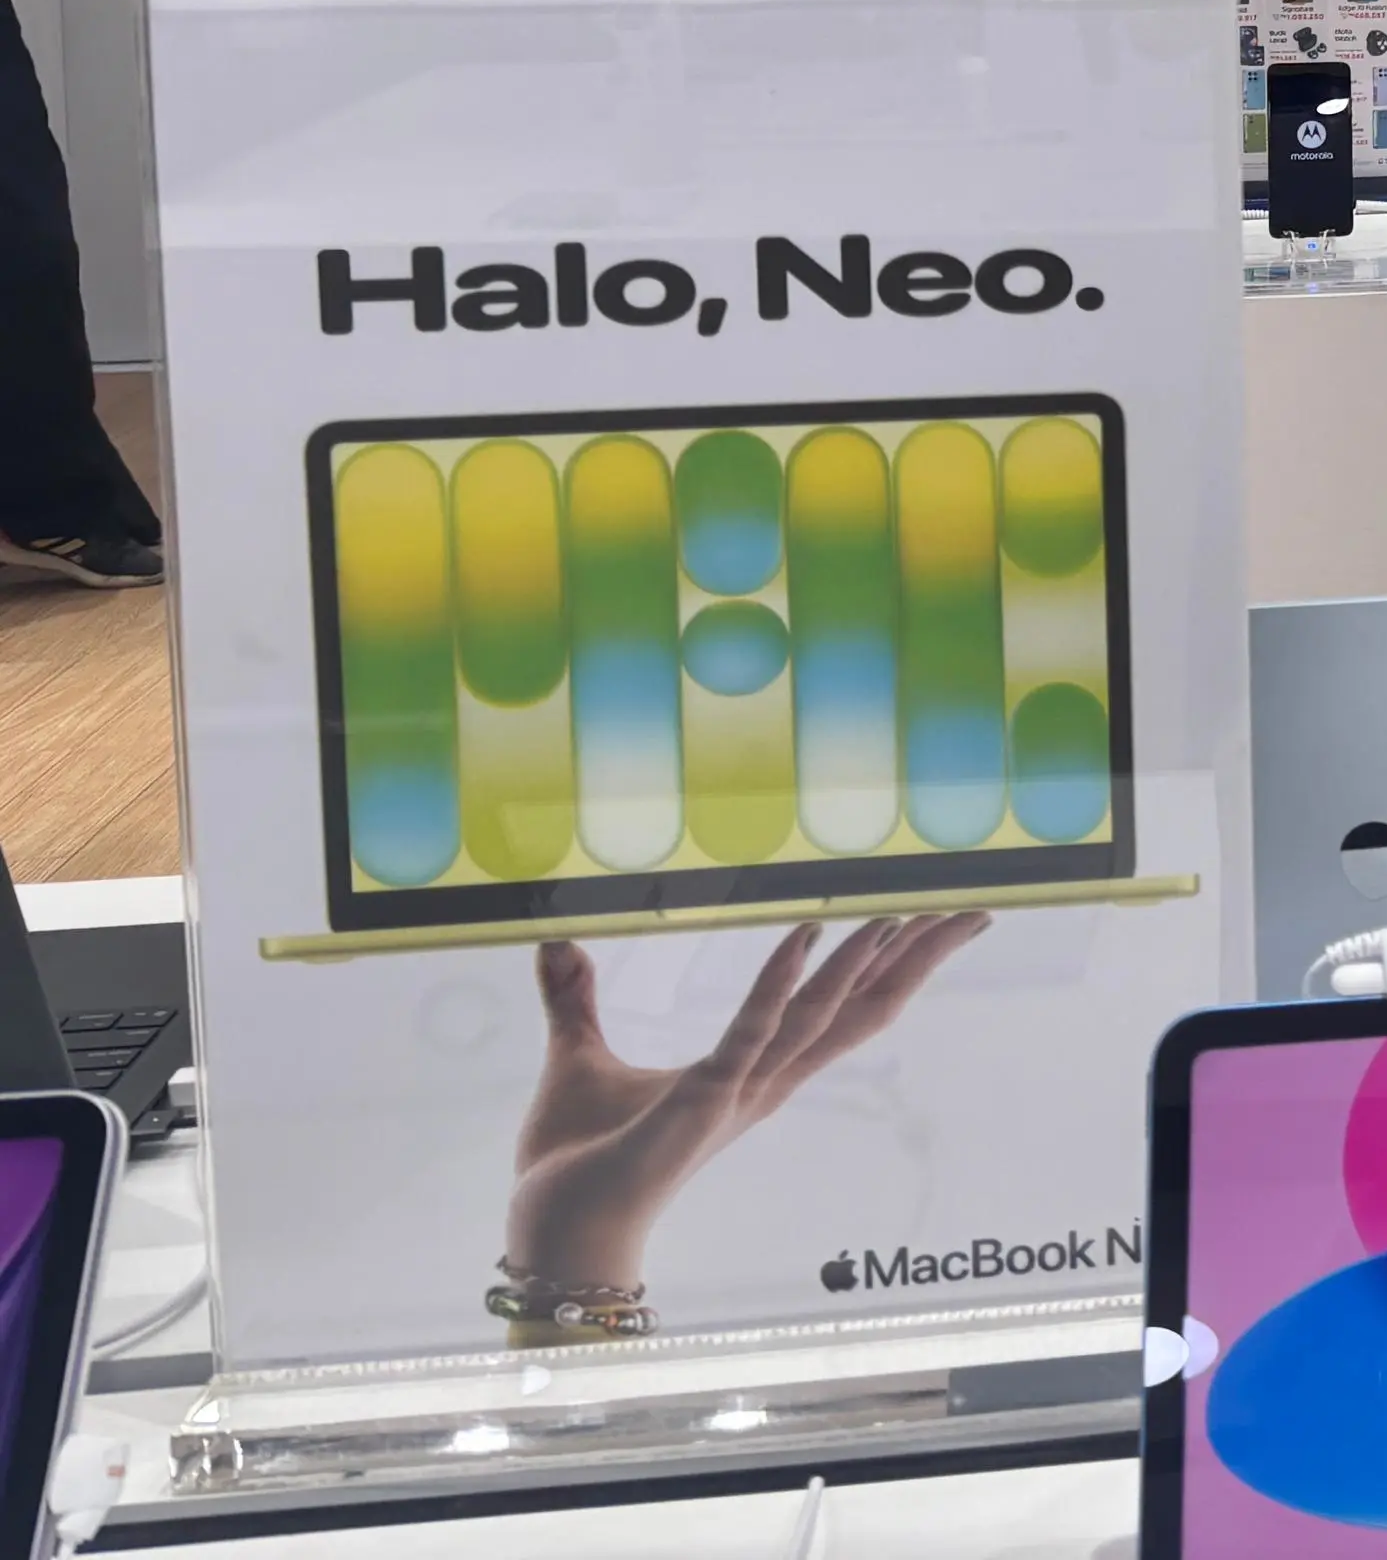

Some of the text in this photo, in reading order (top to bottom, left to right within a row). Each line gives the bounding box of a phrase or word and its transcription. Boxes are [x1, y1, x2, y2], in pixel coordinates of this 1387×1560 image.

[1291, 151, 1334, 161] motorola
[316, 233, 1105, 337] Halo, Neo.
[863, 1229, 1097, 1290] MacBook
